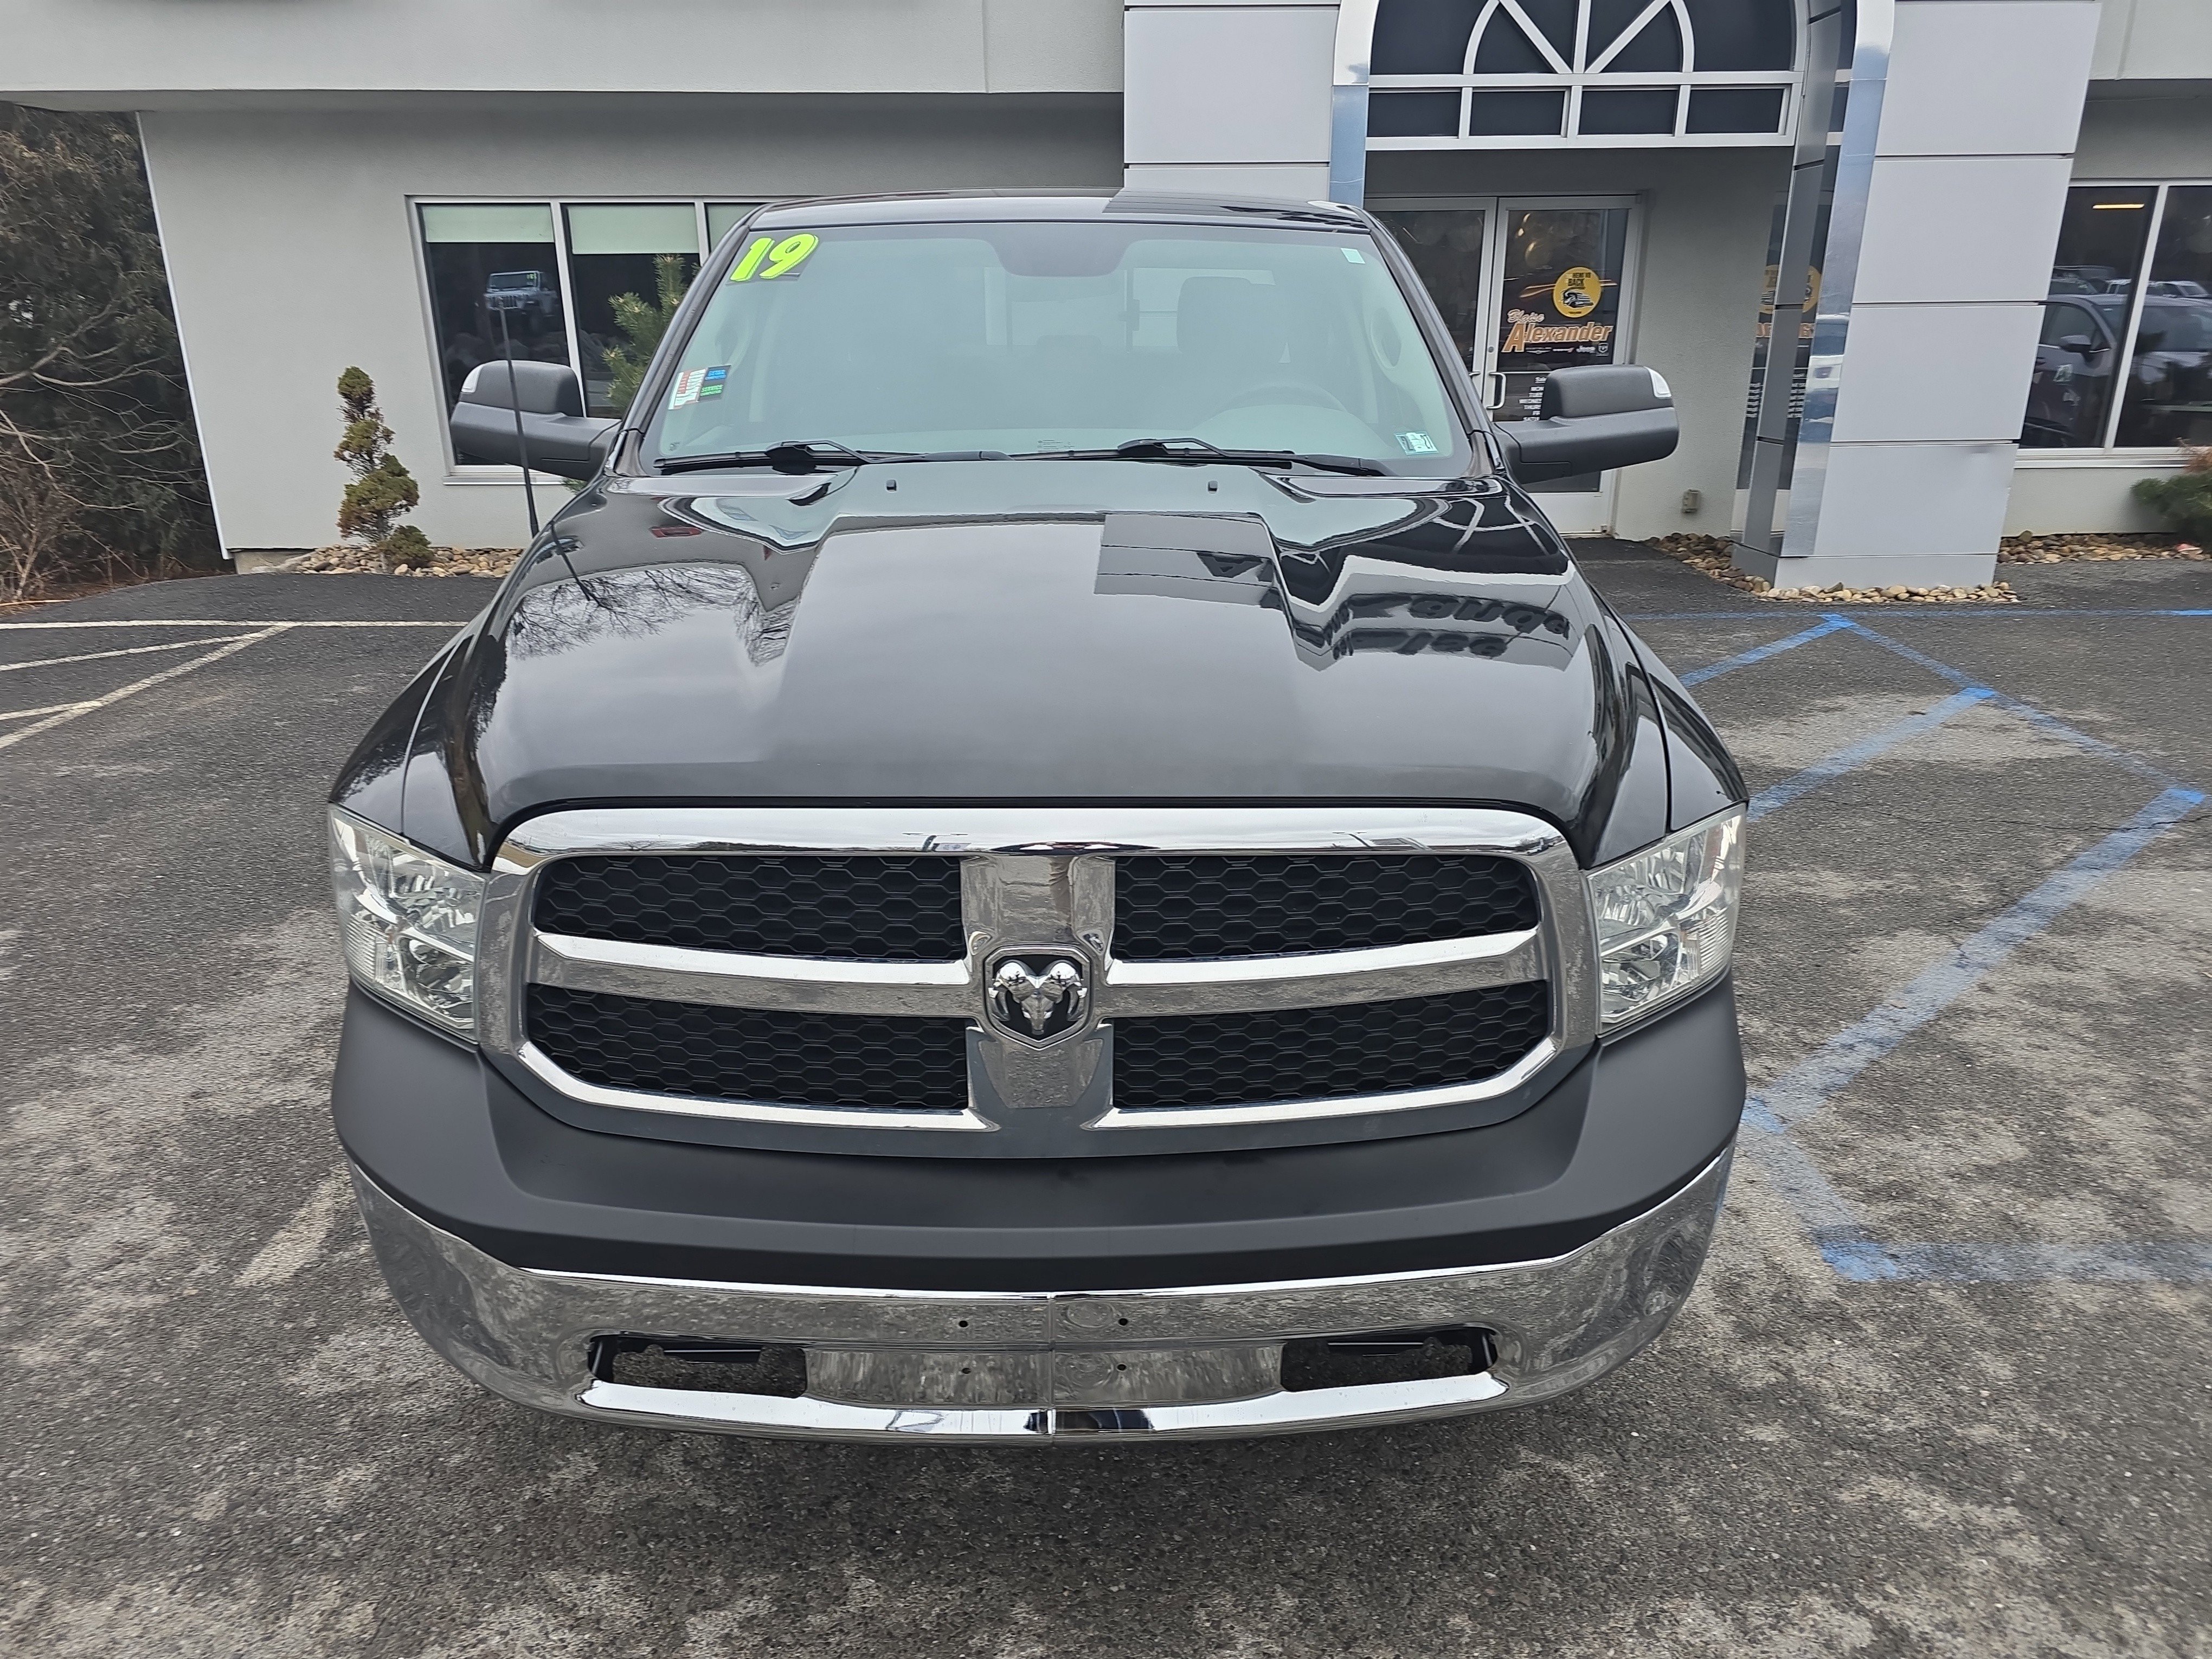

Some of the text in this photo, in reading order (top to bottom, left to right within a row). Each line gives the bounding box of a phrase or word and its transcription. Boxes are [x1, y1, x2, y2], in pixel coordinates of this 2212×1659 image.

[730, 234, 819, 281] 19
[1507, 308, 1545, 323] Blaise
[1501, 322, 1613, 352] Alexander
